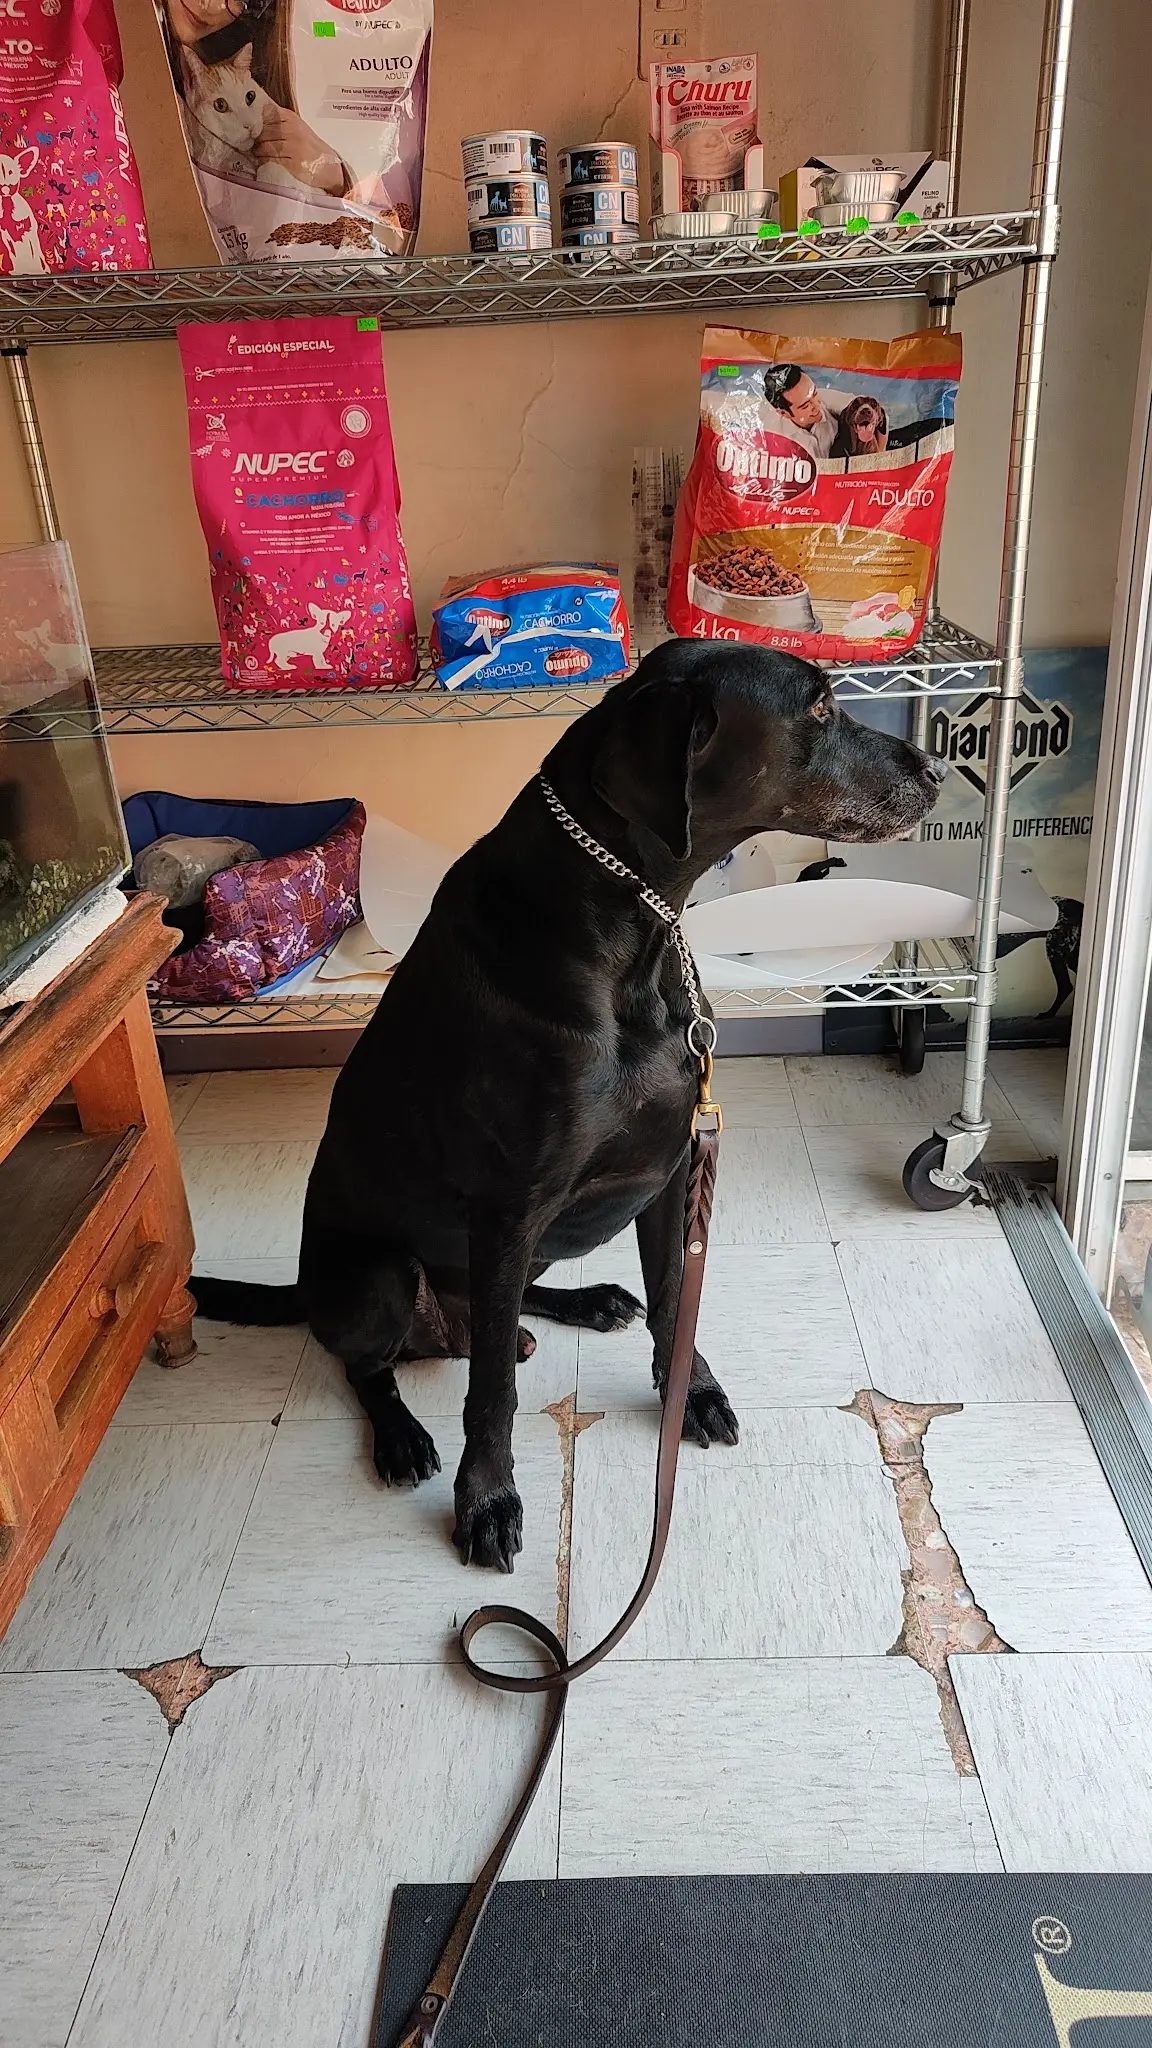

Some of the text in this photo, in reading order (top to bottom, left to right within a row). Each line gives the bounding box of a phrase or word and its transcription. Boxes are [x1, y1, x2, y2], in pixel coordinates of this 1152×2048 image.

[349, 56, 414, 72] ADULTO
[384, 72, 410, 80] ADULT
[667, 79, 752, 107] Churu
[621, 151, 636, 170] CN
[598, 191, 618, 210] CN
[501, 226, 523, 246] CN
[91, 260, 118, 272] 2 kg
[237, 340, 333, 355] EDICIÓN ESPECIAL
[232, 451, 328, 475] NUPEC
[276, 474, 328, 482] PREMIUM
[245, 489, 345, 508] CACHORRO
[868, 489, 935, 507] ADULTO
[782, 506, 812, 516] NUPEC
[524, 611, 581, 629] CACHORRO
[692, 617, 740, 641] 4 kg
[771, 636, 803, 648] 8.8 lb
[370, 672, 378, 680] 2
[475, 661, 532, 680] CACHORRO
[925, 822, 943, 842] TO
[948, 821, 984, 841] MAK
